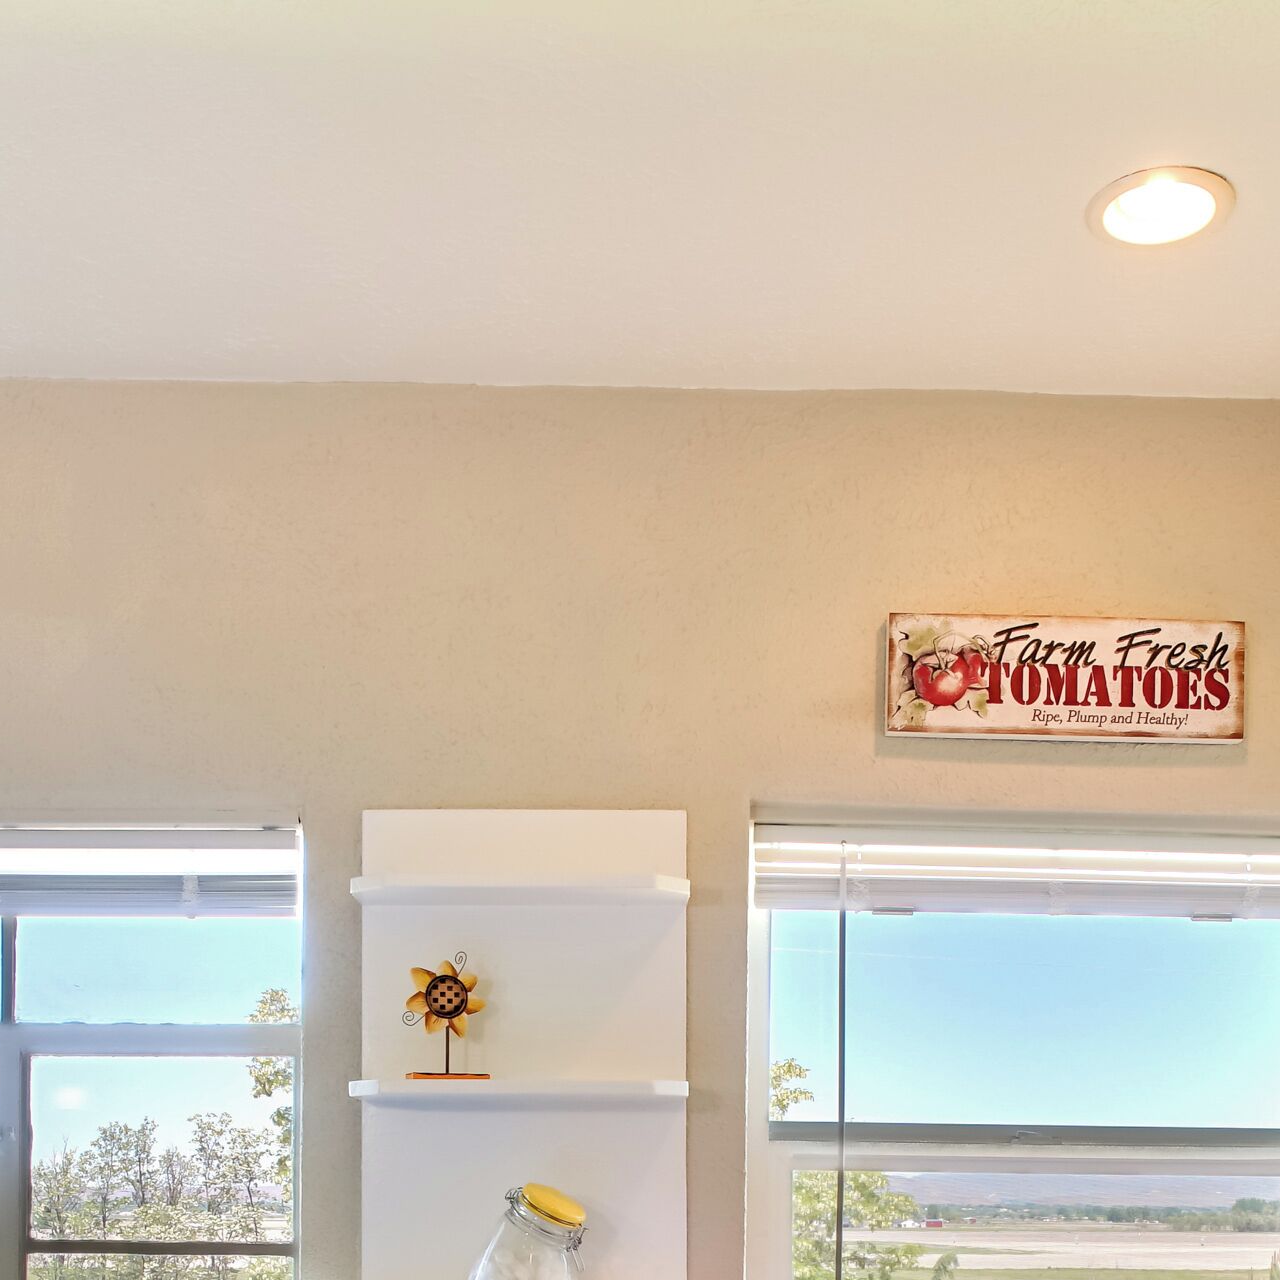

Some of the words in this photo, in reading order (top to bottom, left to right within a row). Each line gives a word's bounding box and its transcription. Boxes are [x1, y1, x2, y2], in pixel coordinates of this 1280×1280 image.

[993, 622, 1097, 667] Farm
[1114, 627, 1230, 671] Fresh
[981, 661, 1231, 711] TOMATOES
[1031, 708, 1063, 726] Ripe,
[1066, 709, 1107, 727] Plump
[1110, 712, 1134, 724] and
[1136, 712, 1189, 730] Healthy!
